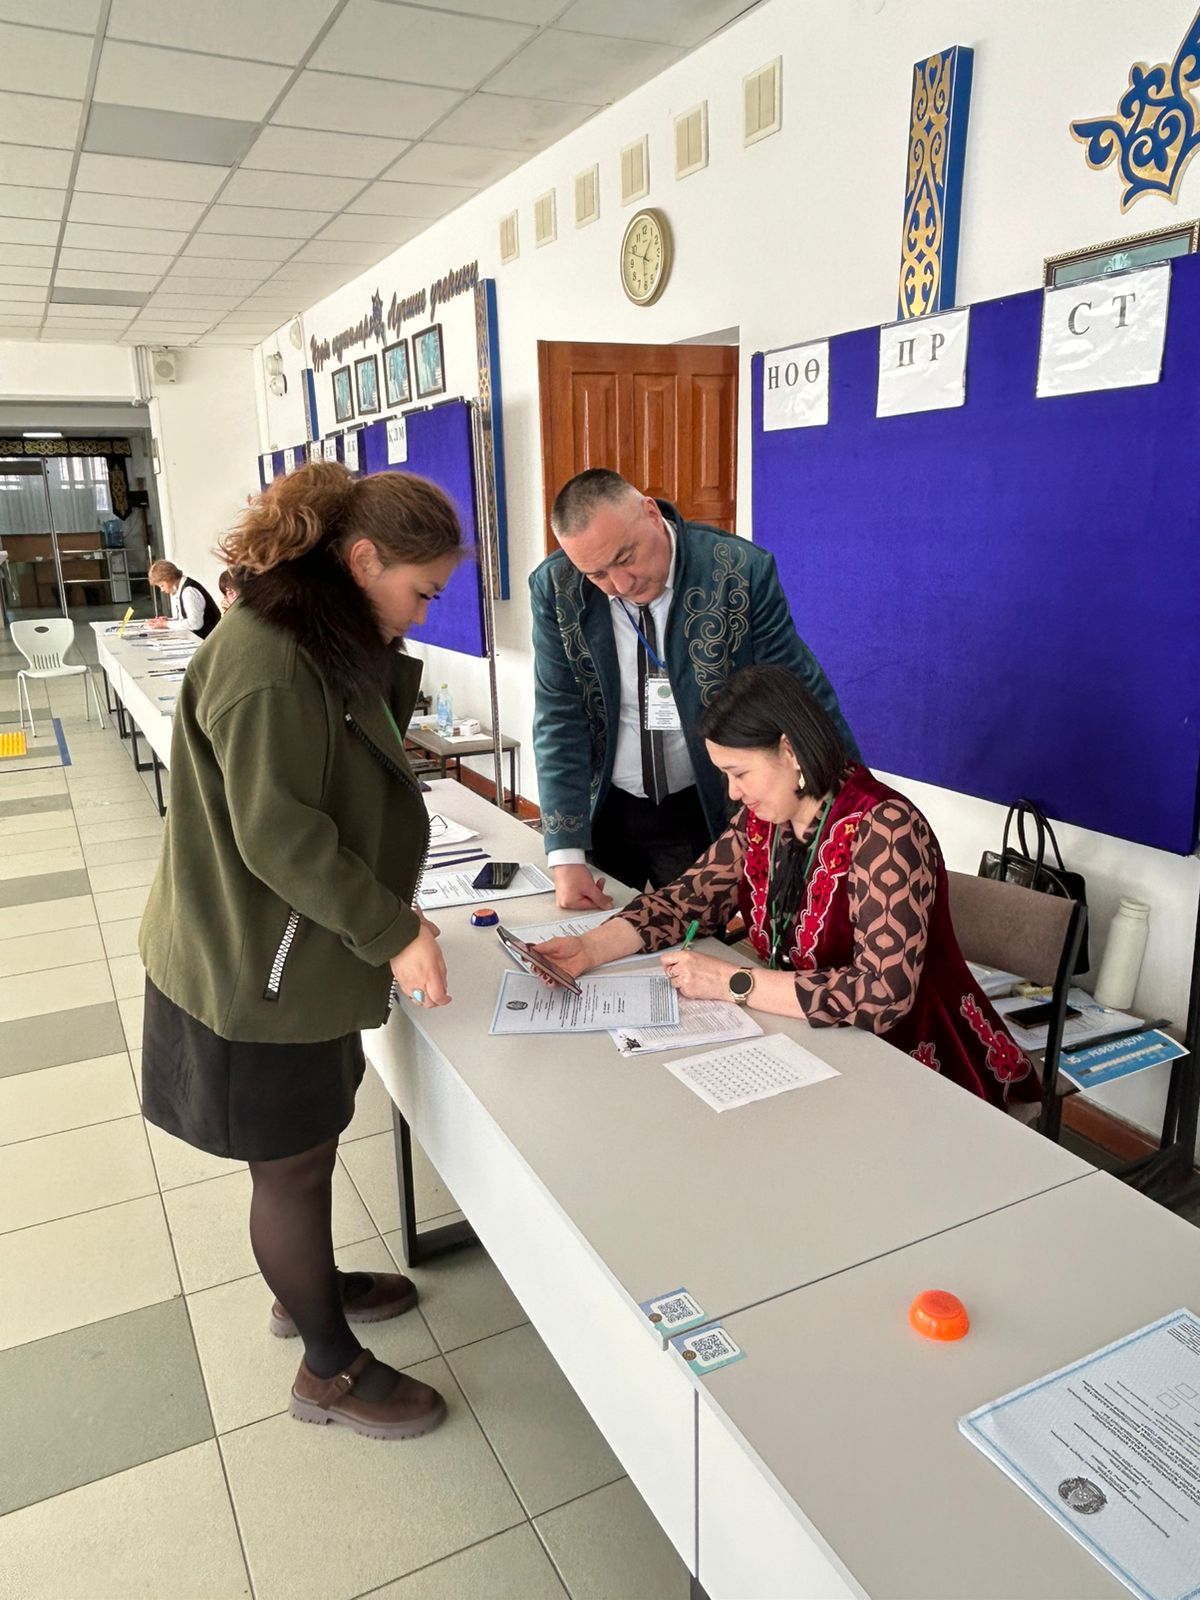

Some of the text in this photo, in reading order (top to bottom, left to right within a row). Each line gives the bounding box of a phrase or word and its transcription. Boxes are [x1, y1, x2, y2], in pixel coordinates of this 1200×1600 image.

[1067, 292, 1136, 336] С Т
[897, 332, 946, 368] П Р
[767, 359, 820, 391] НОӨ
